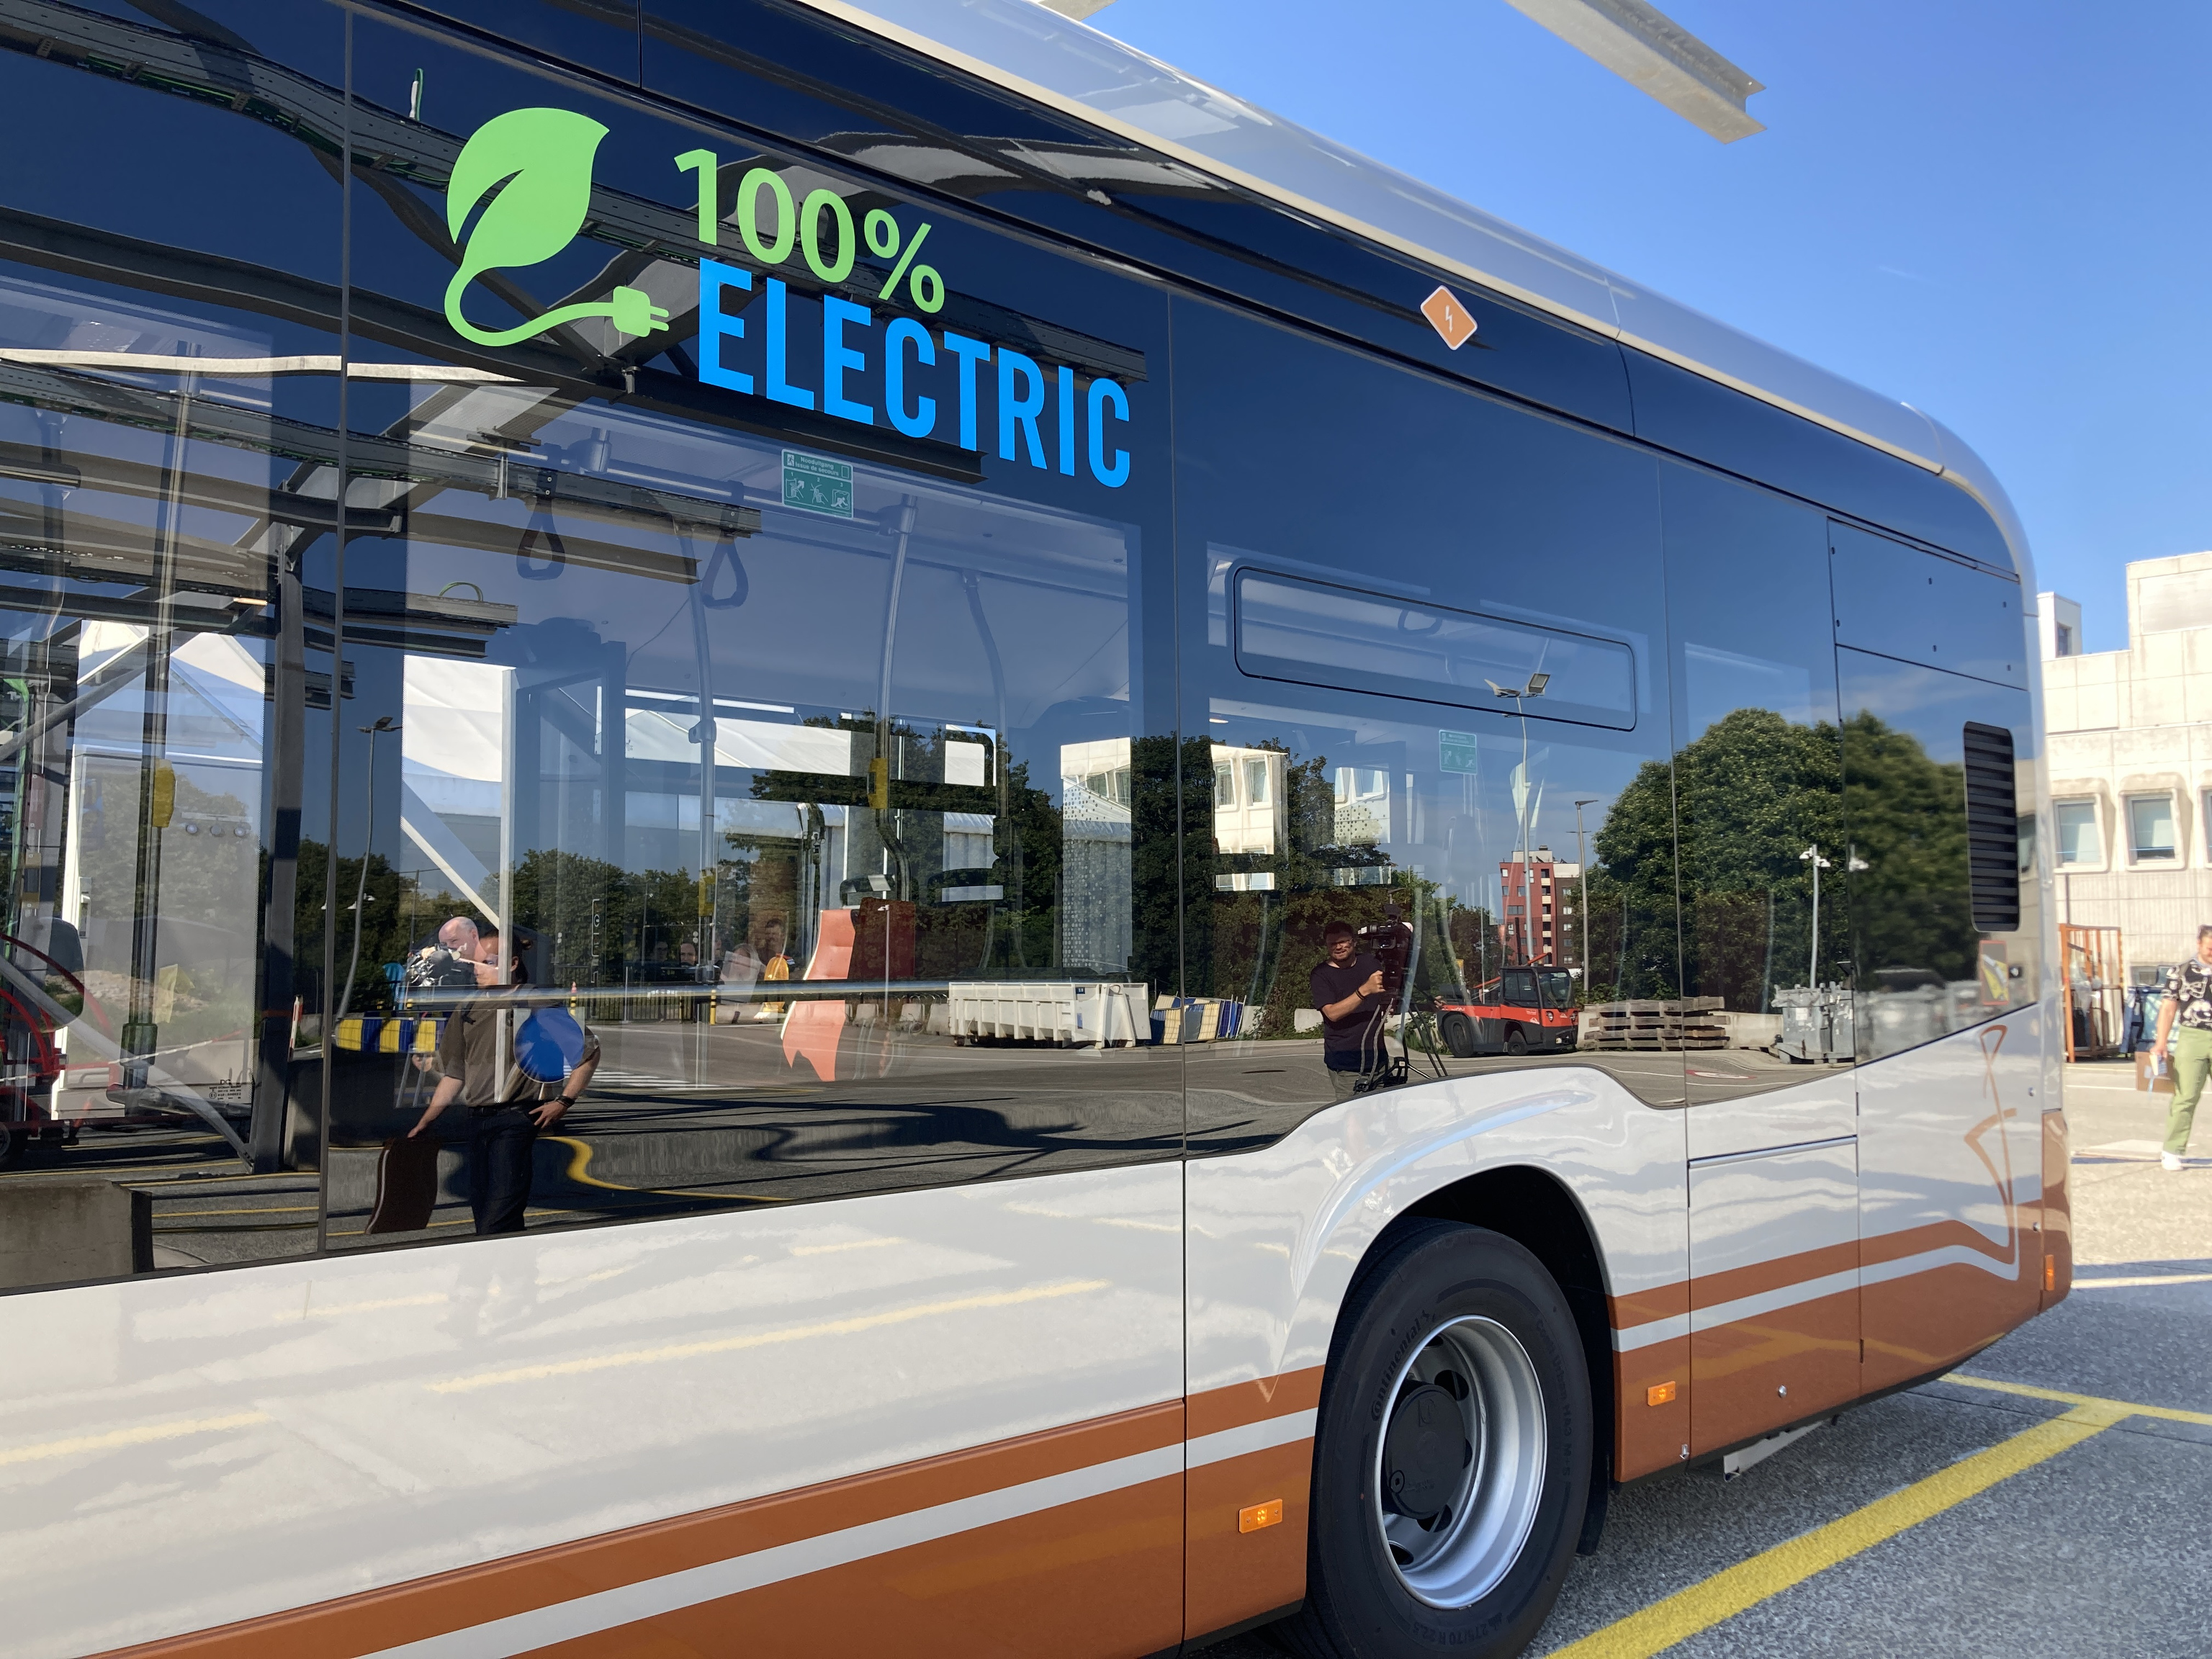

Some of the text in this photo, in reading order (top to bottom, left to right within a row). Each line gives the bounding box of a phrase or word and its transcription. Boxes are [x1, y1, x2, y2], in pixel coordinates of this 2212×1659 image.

[674, 148, 945, 313] 100%
[698, 256, 1130, 488] ELECTRIC
[800, 456, 834, 469] Nooduitgang
